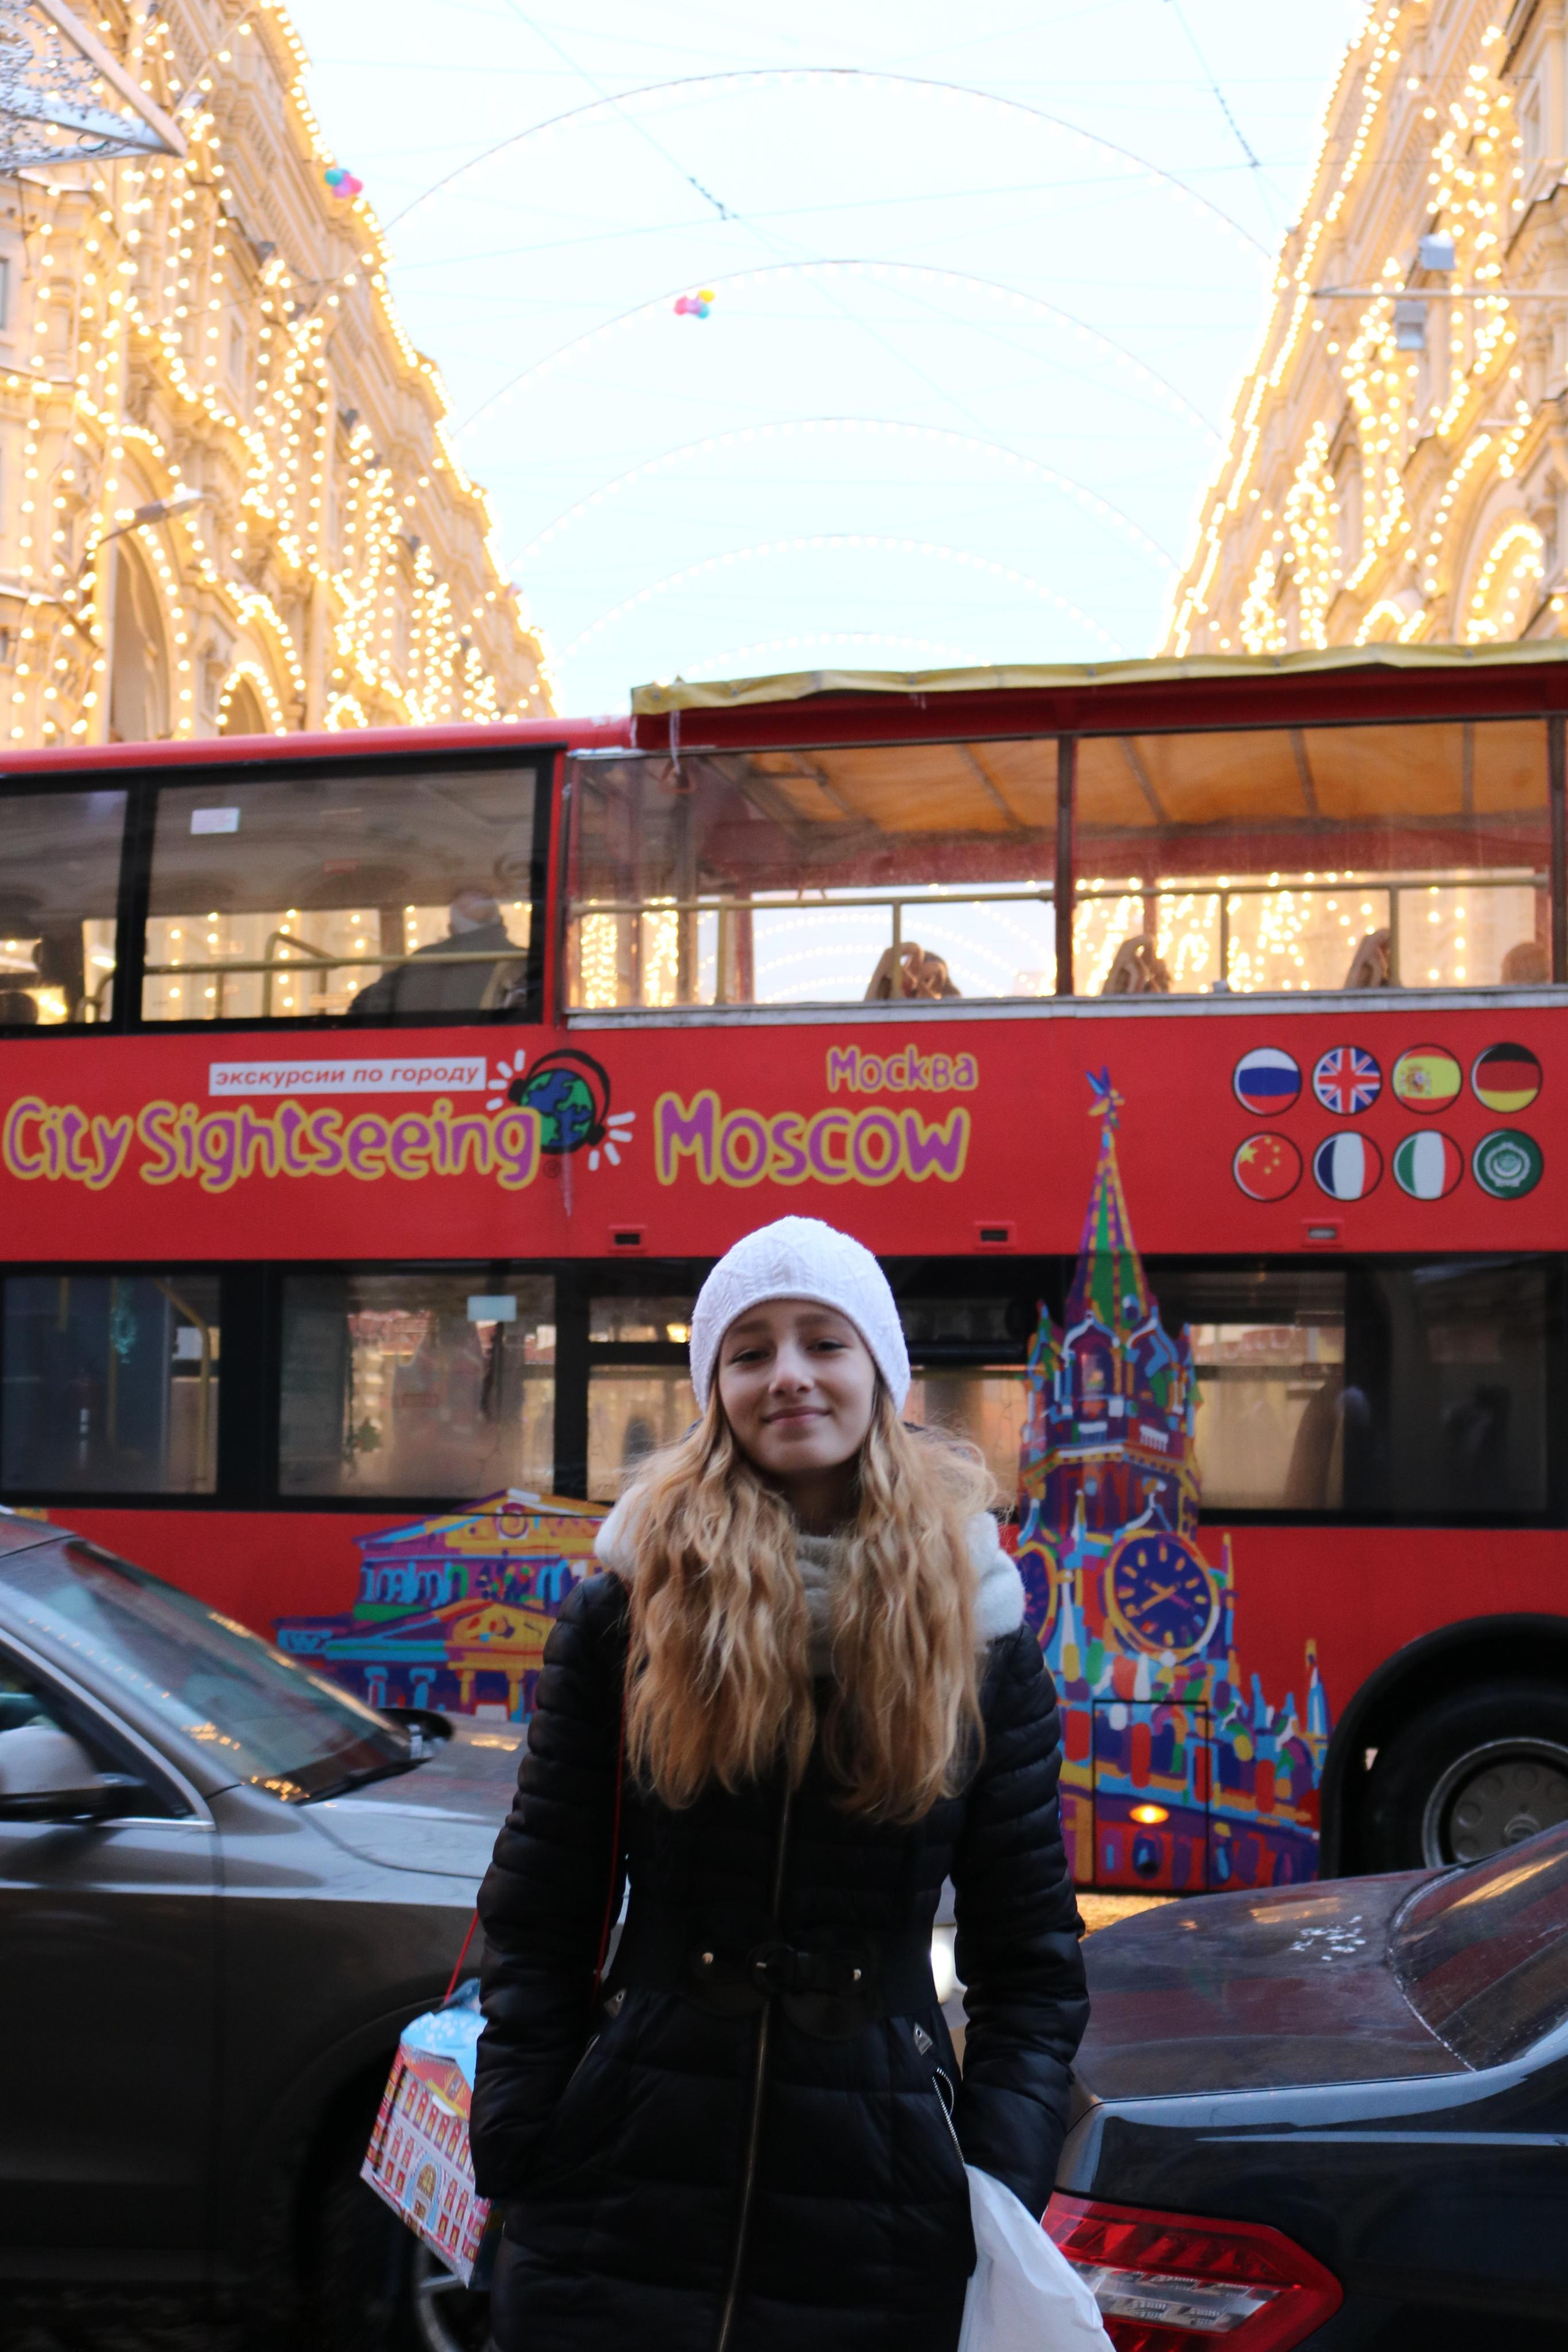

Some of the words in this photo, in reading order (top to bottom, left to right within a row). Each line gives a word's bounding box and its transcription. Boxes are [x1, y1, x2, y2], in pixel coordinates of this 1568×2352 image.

[216, 1069, 344, 1088] экскурсии
[352, 1068, 382, 1082] по
[391, 1066, 479, 1085] городу
[827, 1044, 978, 1091] Москва
[3, 1096, 132, 1189] City
[137, 1098, 540, 1193] Sightseeing
